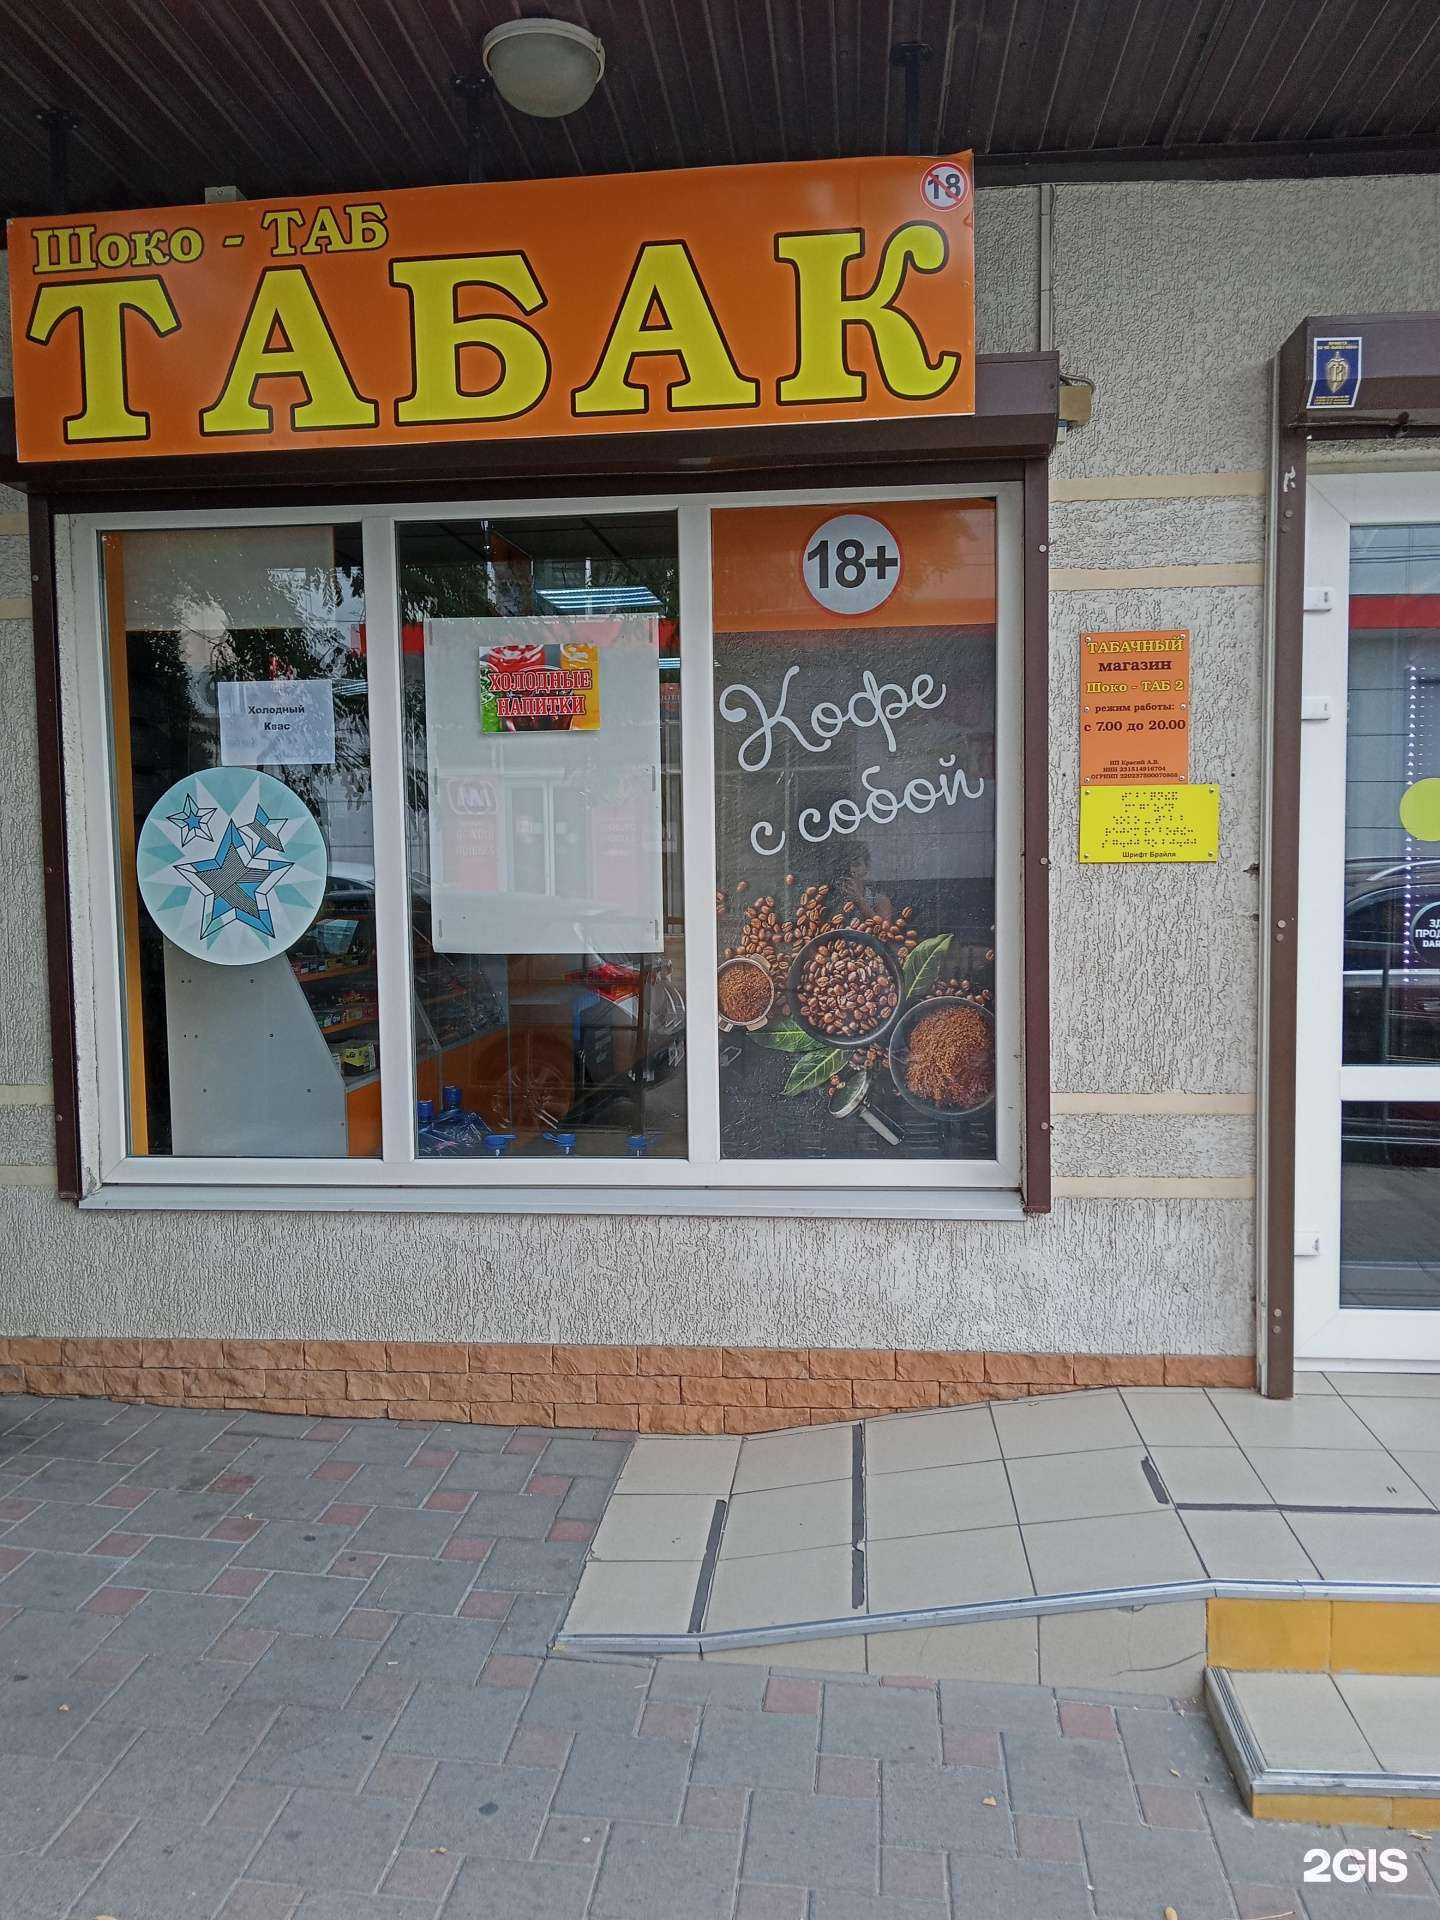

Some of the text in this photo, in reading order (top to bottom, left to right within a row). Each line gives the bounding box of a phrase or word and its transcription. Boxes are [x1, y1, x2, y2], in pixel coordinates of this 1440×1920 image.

[928, 173, 961, 200] 18
[32, 226, 203, 275] Шоко
[262, 203, 389, 256] ТАБ
[26, 221, 959, 444] ТАБАК
[807, 538, 898, 589] 18+
[1087, 636, 1184, 654] ТАБАЧНЫЙ
[1098, 660, 1172, 672] магазин
[488, 669, 592, 693] ХОЛОДНЫЕ
[1086, 682, 1128, 693] Шоко
[1141, 681, 1171, 692] ТАБ
[1175, 680, 1184, 691] 2
[247, 704, 305, 715] Холодный
[497, 695, 586, 716] НАПИТКИ
[1095, 703, 1175, 714] режим работы:
[264, 721, 291, 731] Квас
[719, 665, 947, 772] Кофе
[1096, 721, 1123, 732] 7.00
[1126, 723, 1144, 732] до
[1148, 720, 1186, 731] 20.00
[750, 753, 985, 856] с собой
